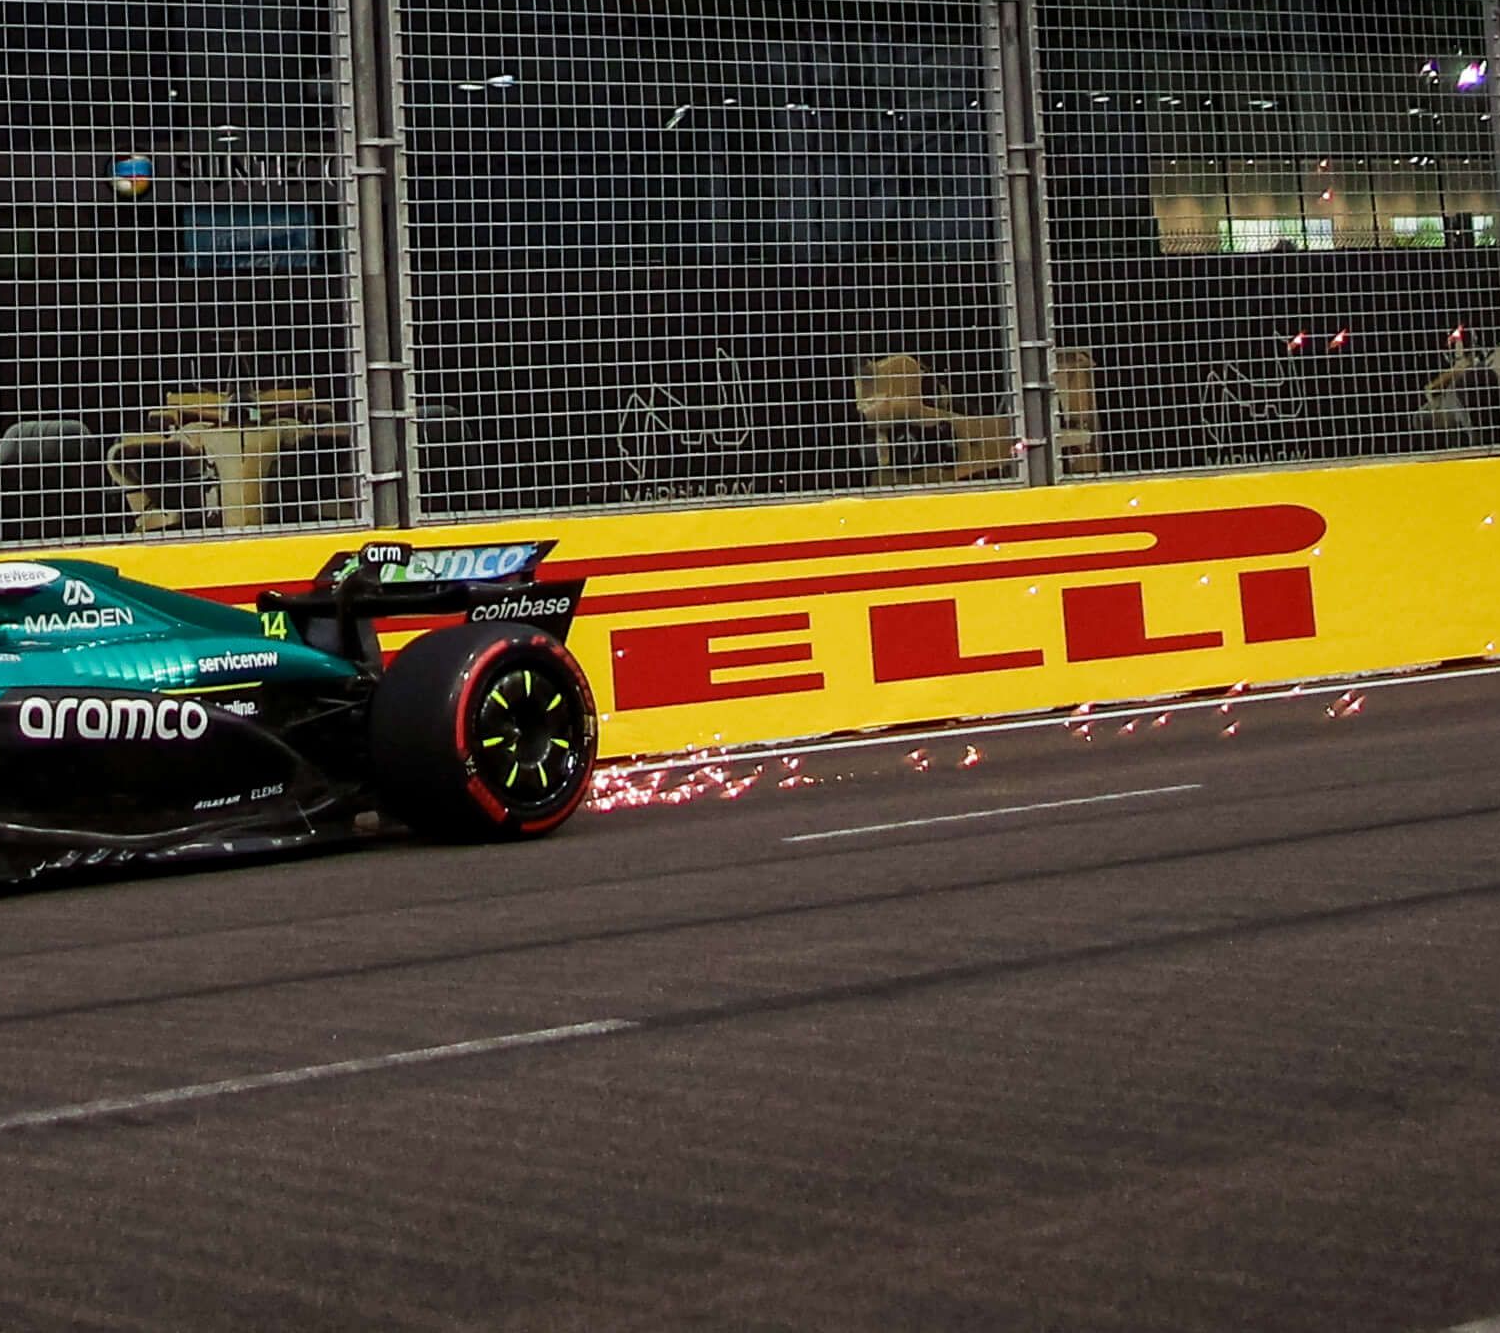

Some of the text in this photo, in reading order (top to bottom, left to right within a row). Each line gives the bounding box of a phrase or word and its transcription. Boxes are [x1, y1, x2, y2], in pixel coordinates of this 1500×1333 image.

[367, 545, 402, 563] arm
[379, 545, 528, 584] ramco
[24, 606, 134, 635] MAADEN
[471, 594, 571, 624] coinbase
[261, 611, 288, 640] 14
[198, 649, 279, 674] servicenow
[19, 696, 209, 740] aramco
[250, 782, 284, 801] ELEMIS
